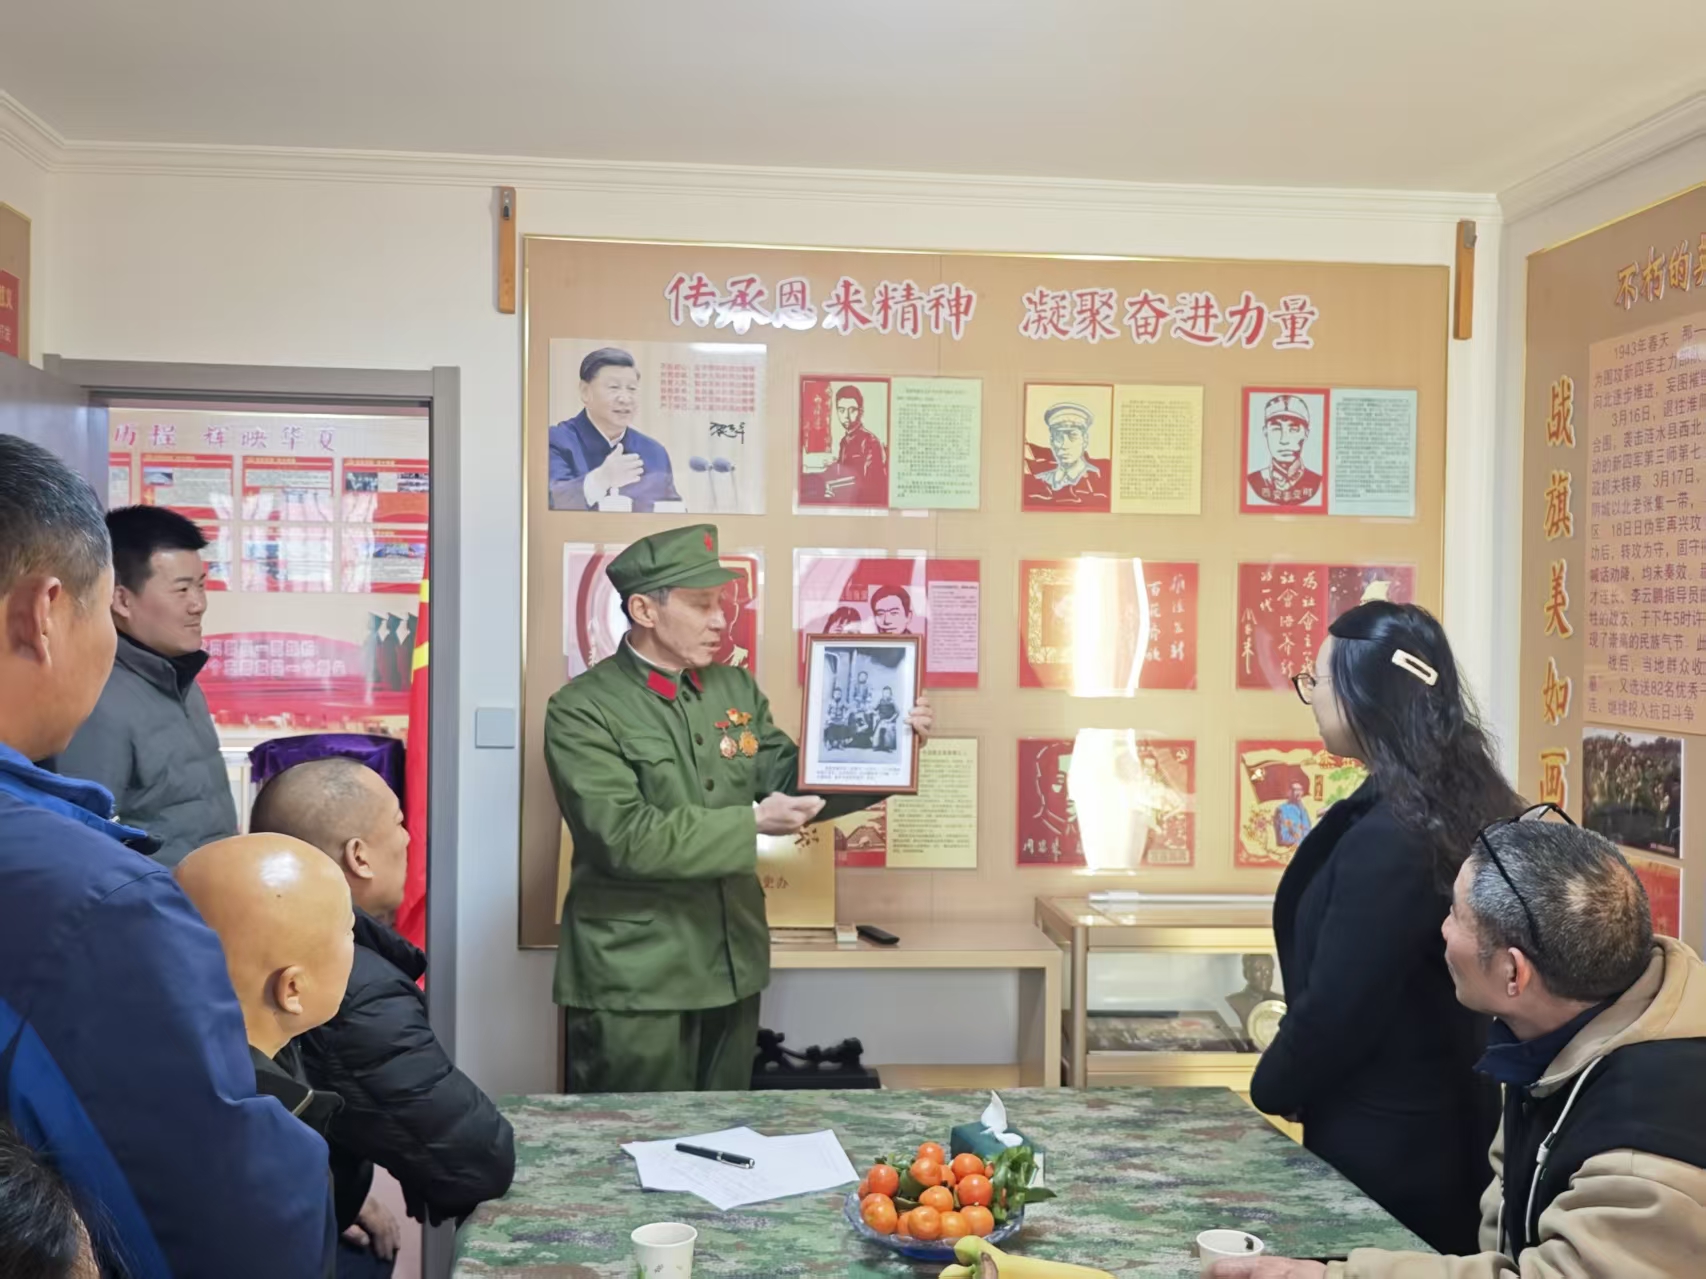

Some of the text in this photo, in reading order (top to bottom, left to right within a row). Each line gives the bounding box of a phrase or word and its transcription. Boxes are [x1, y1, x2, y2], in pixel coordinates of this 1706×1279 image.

[1616, 232, 1706, 309] 不朽的
[666, 273, 1318, 348] 传承恩来精神 凝聚奋进力量
[1540, 374, 1575, 808] 战旗美如画
